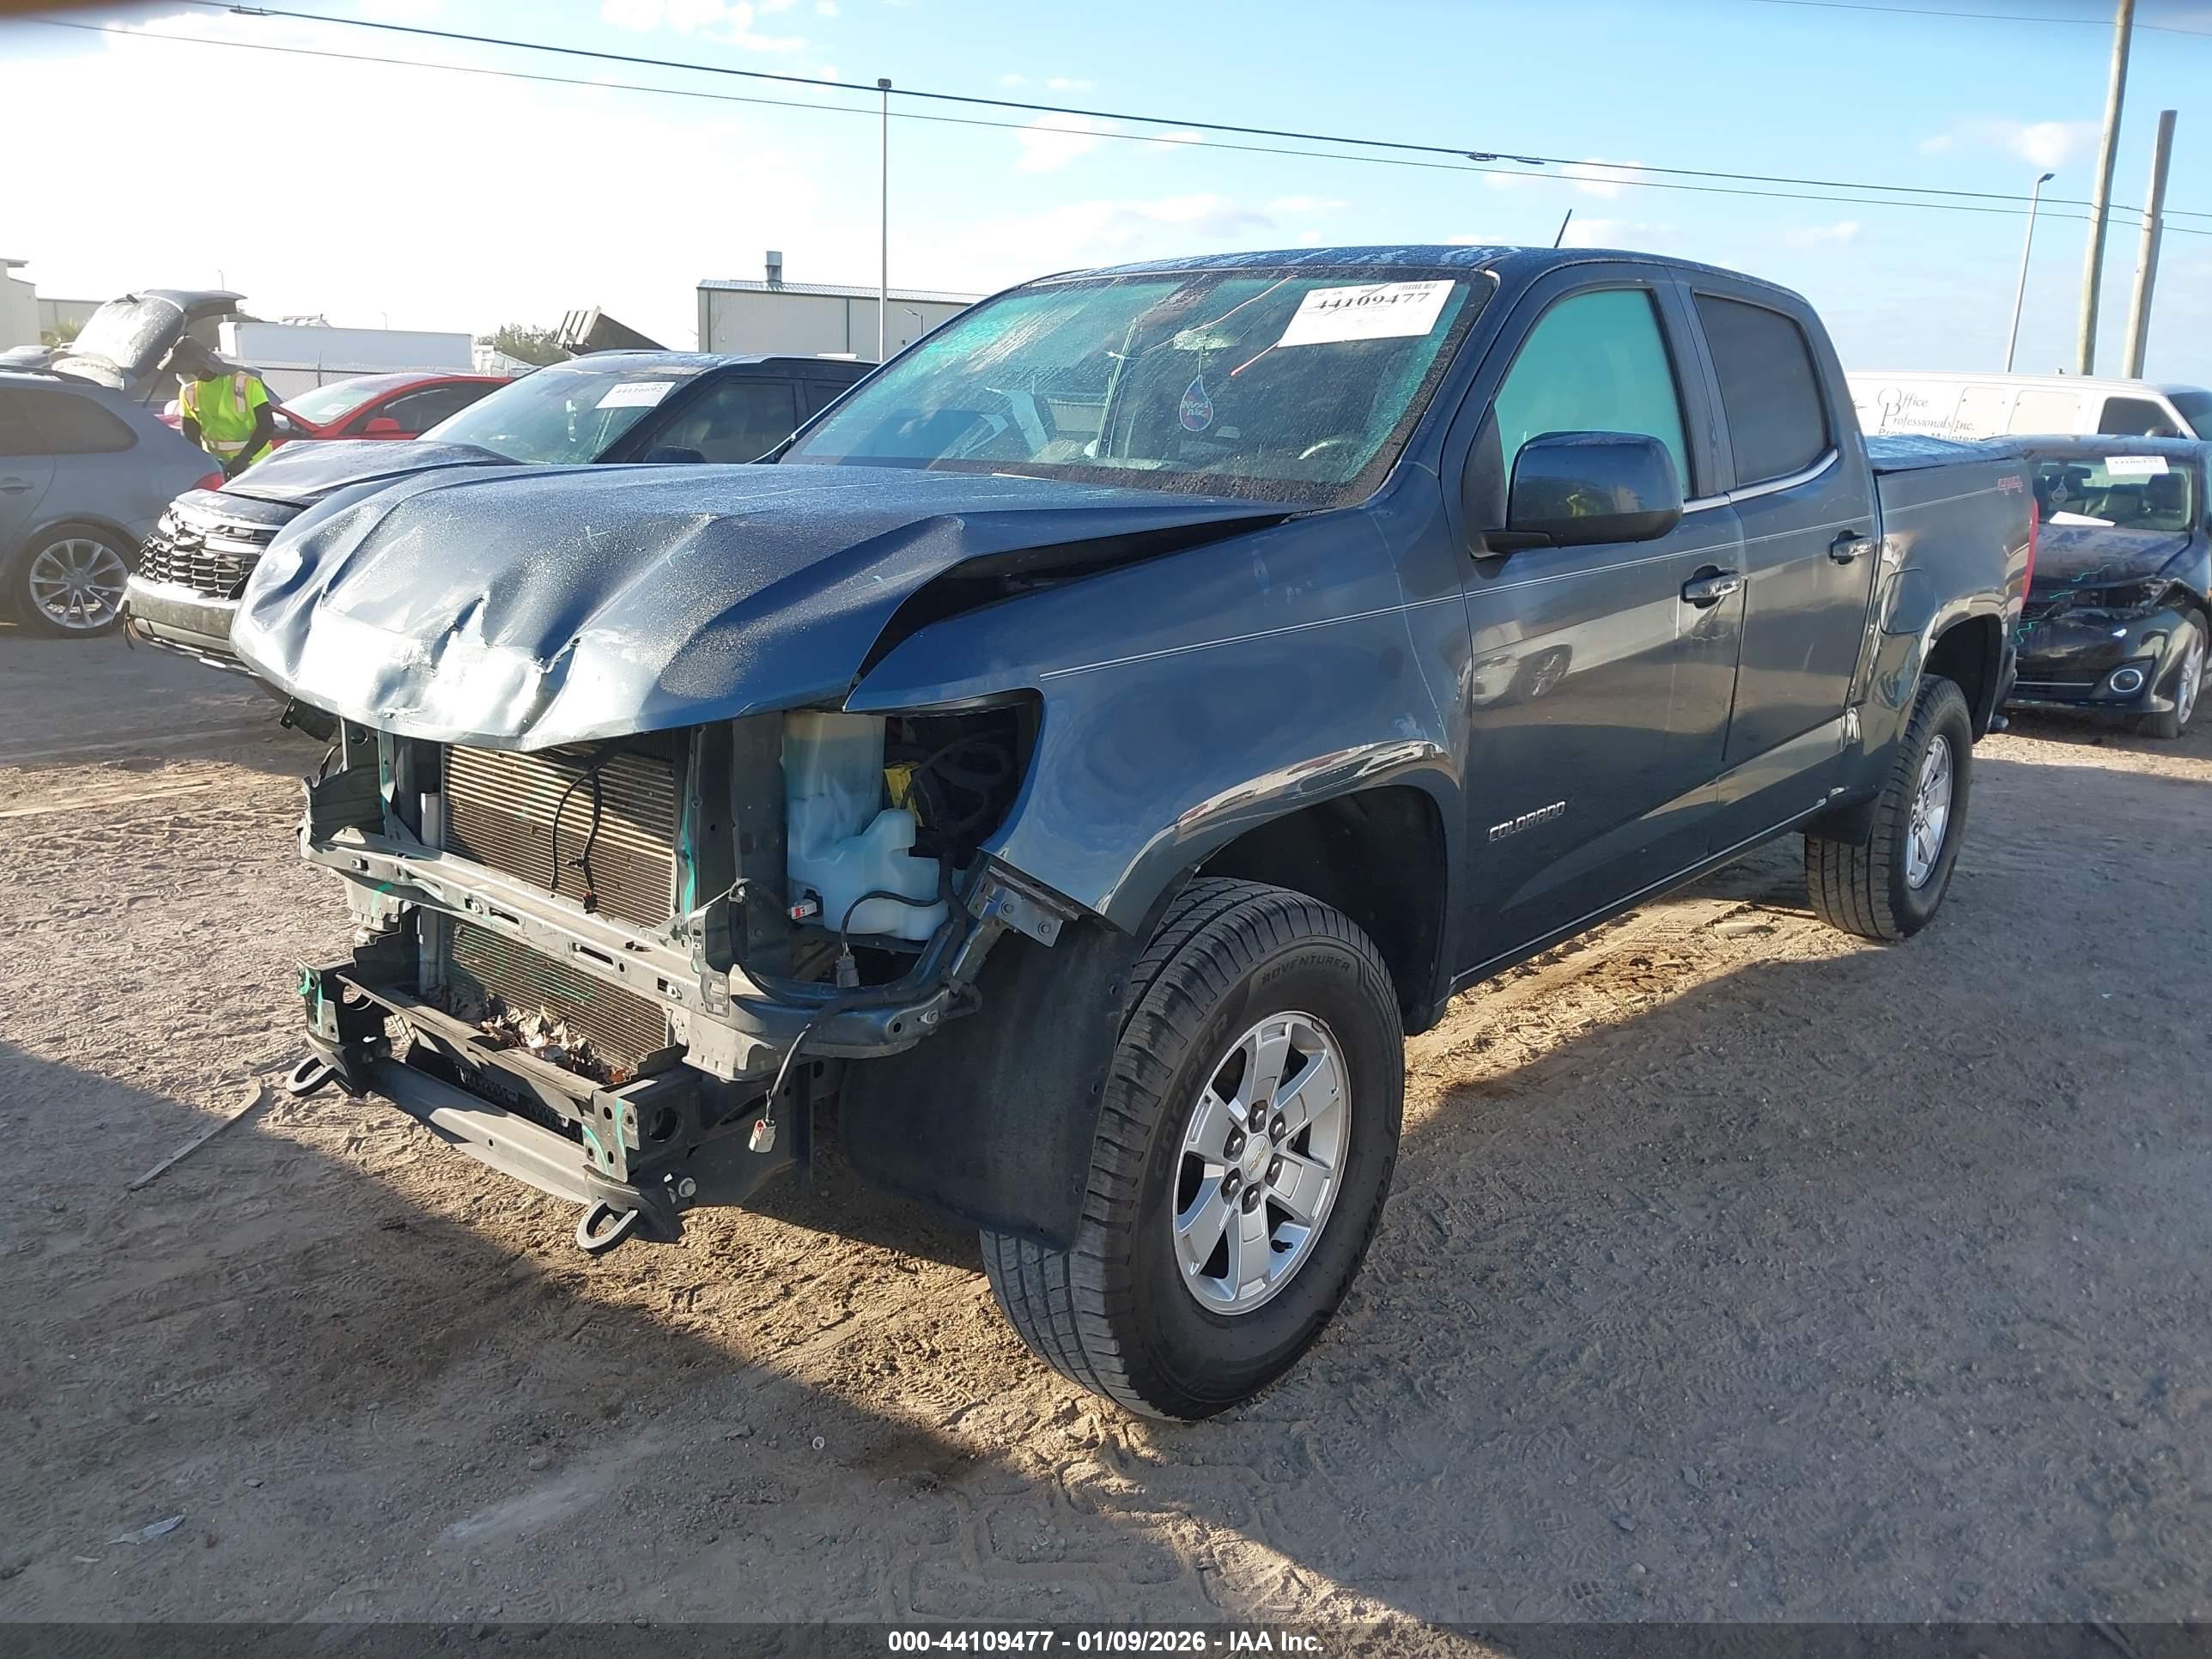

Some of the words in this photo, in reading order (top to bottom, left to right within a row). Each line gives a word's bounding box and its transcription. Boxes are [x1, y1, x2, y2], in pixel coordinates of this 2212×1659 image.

[1314, 292, 1431, 310] 44109477
[1877, 387, 1929, 408] Office
[1881, 402, 1952, 429] Professionals
[1954, 420, 1975, 431] Inc.
[1489, 800, 1566, 842] COLORADO
